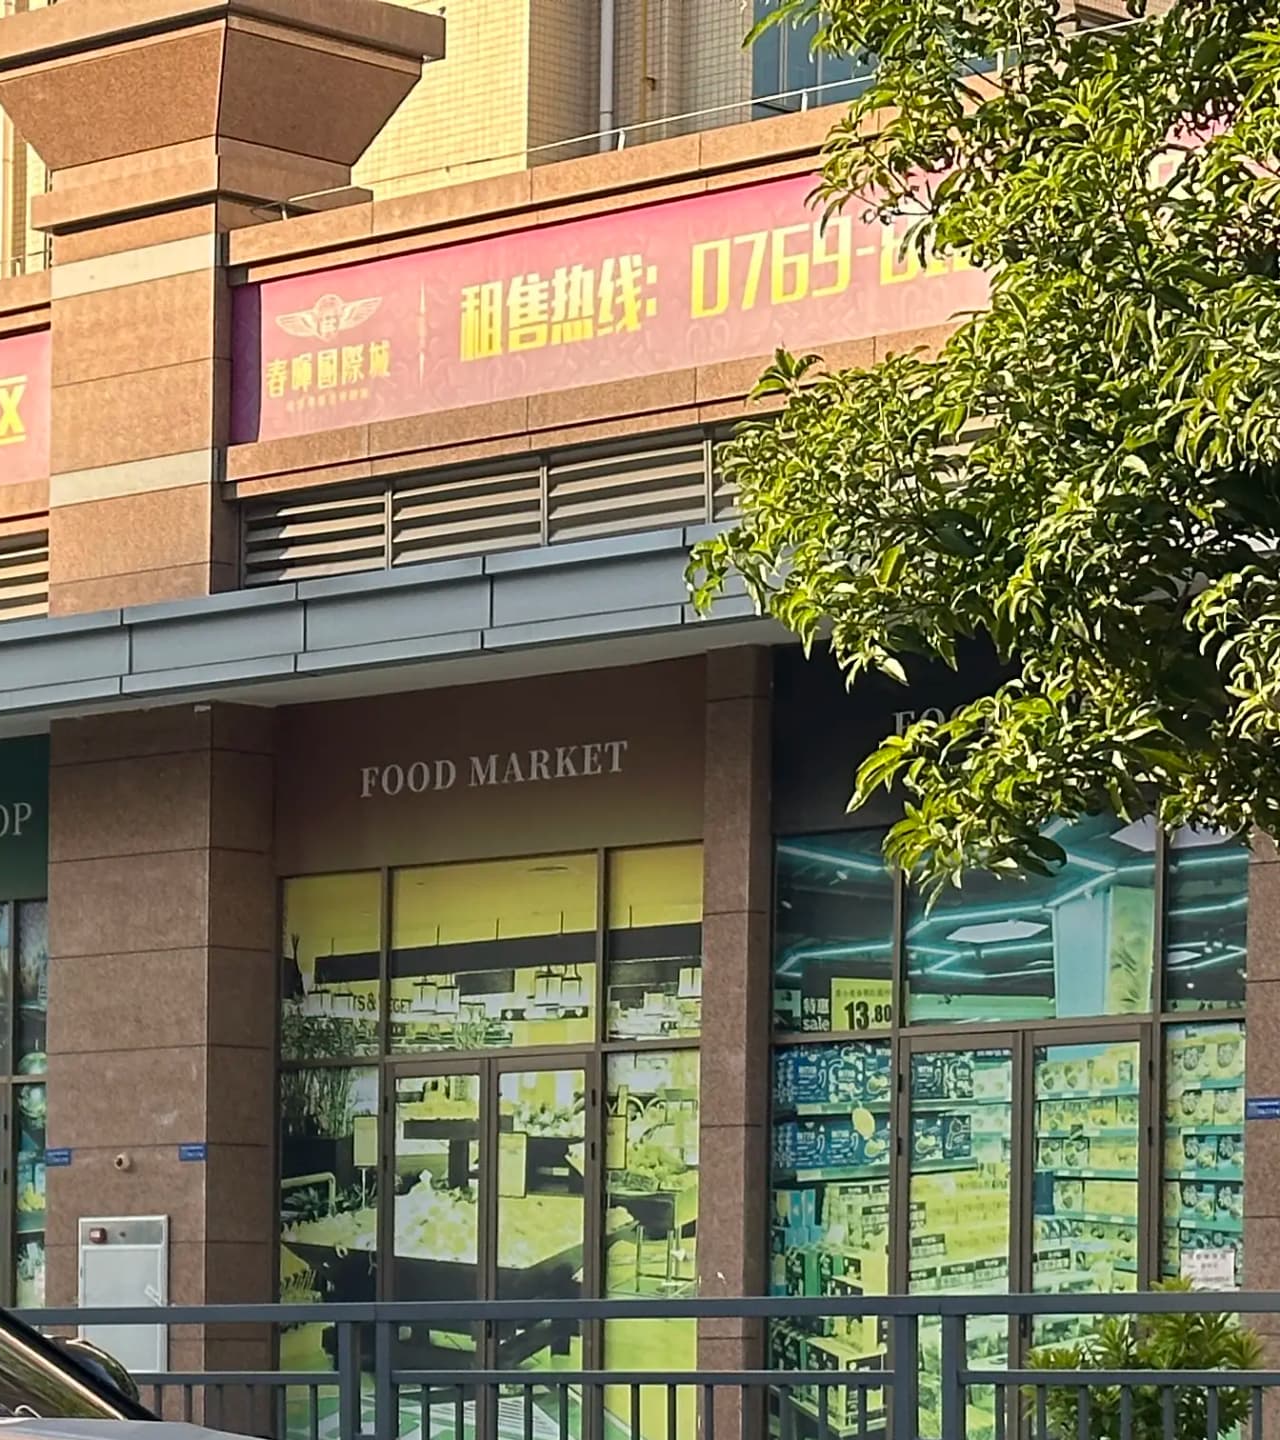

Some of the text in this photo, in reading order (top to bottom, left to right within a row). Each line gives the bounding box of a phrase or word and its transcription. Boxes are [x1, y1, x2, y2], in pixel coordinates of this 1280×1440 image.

[360, 739, 628, 798] FOOD MARKET
[803, 1016, 830, 1031] sale
[844, 1001, 892, 1031] 13.80
